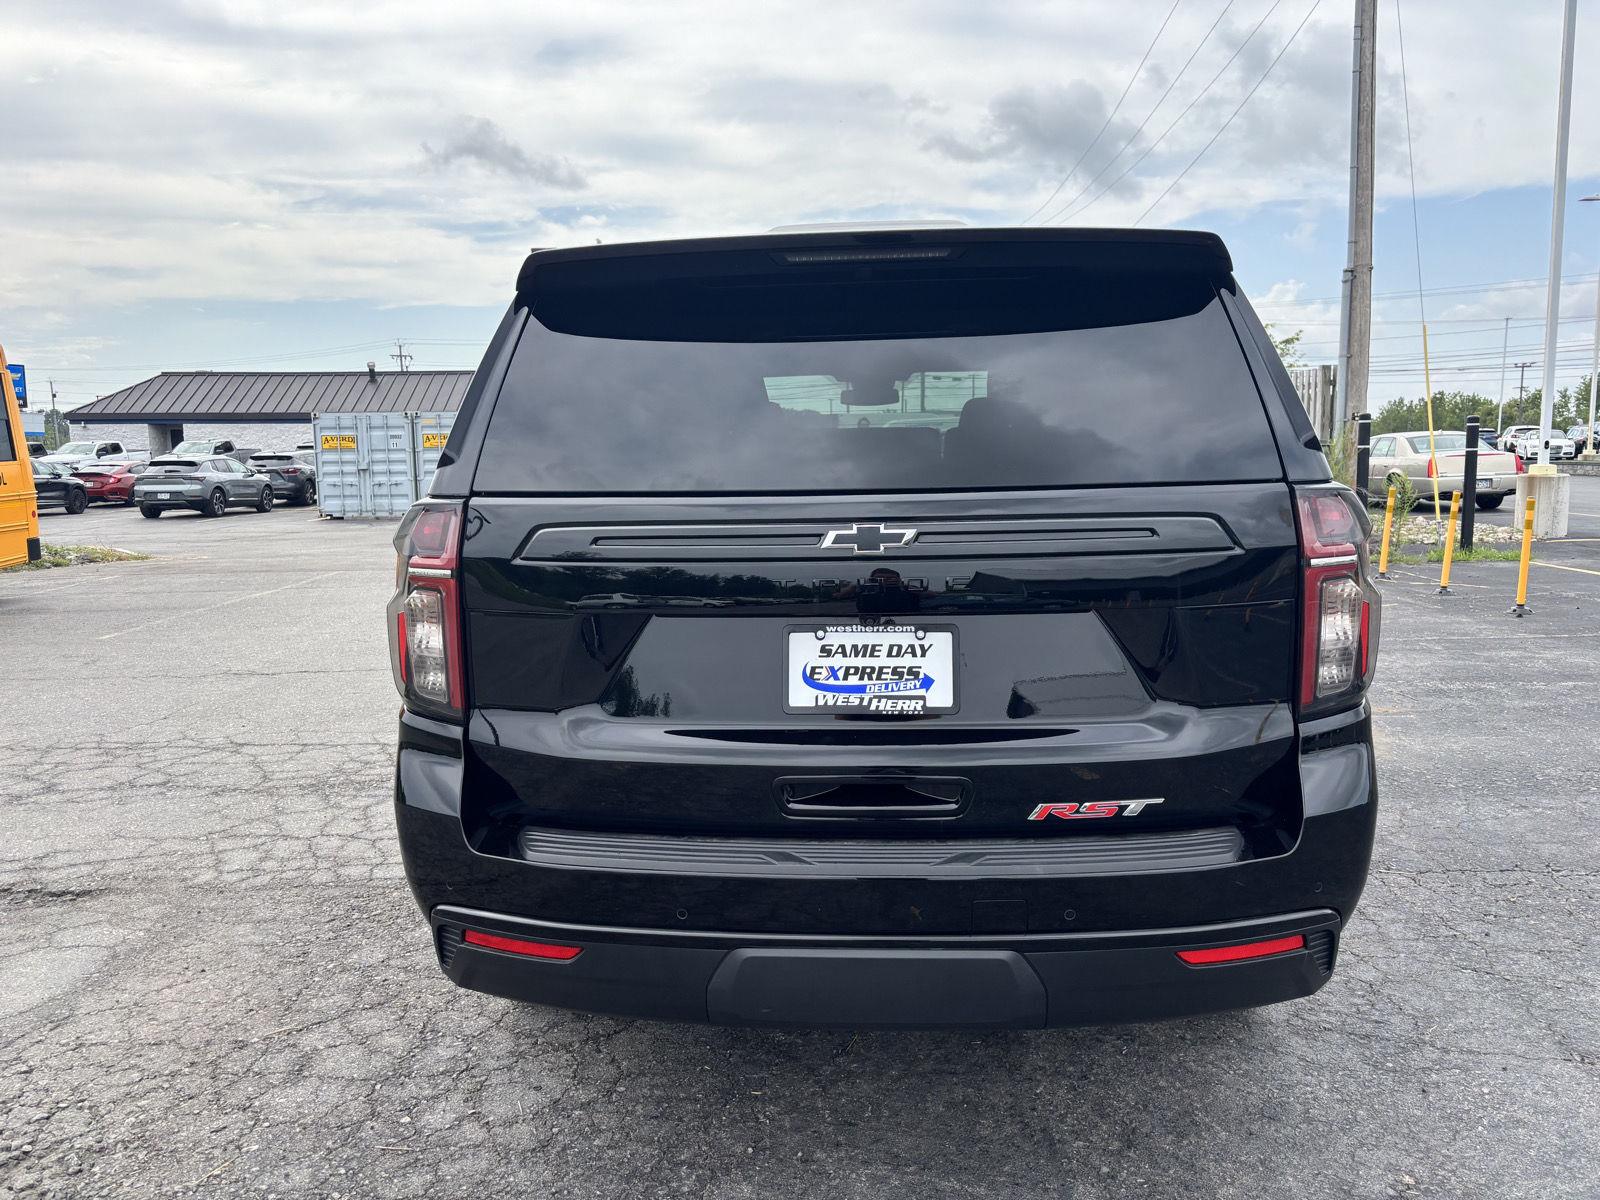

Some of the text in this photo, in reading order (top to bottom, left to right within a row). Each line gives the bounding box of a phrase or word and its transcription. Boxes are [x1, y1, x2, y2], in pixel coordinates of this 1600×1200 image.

[818, 643, 933, 658] SAME DAY
[809, 665, 922, 681] EXPRESS
[865, 679, 923, 694] DELIVERY
[816, 694, 924, 711] WEST HERR
[1027, 798, 1165, 820] RST
